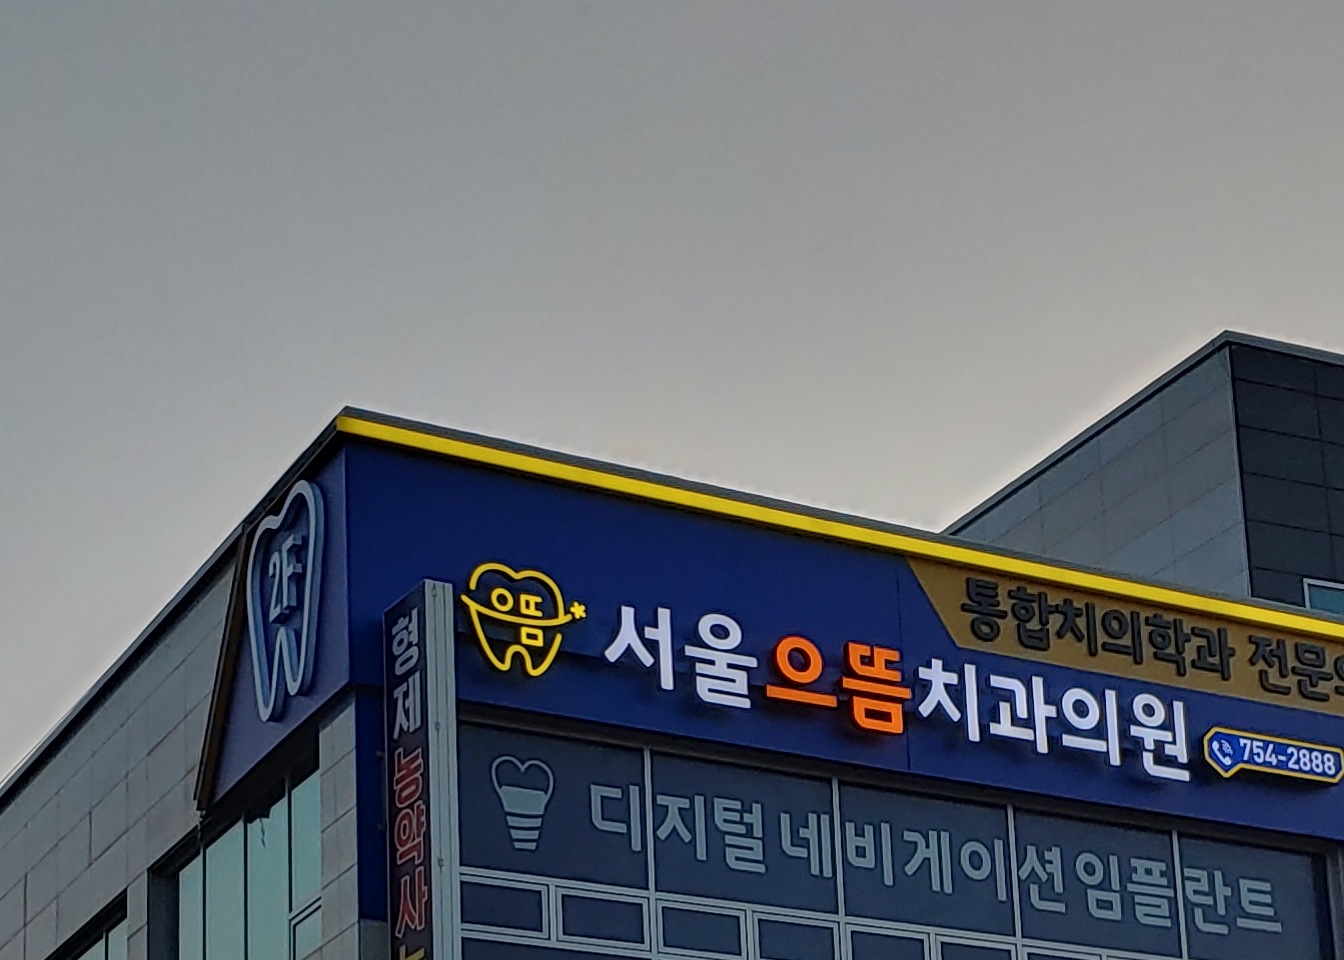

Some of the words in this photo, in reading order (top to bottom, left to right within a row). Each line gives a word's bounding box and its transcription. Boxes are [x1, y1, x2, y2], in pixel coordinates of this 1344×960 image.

[268, 534, 304, 623] 2F
[960, 575, 1235, 681] 통합치의학과
[1238, 736, 1339, 777] 754-2888
